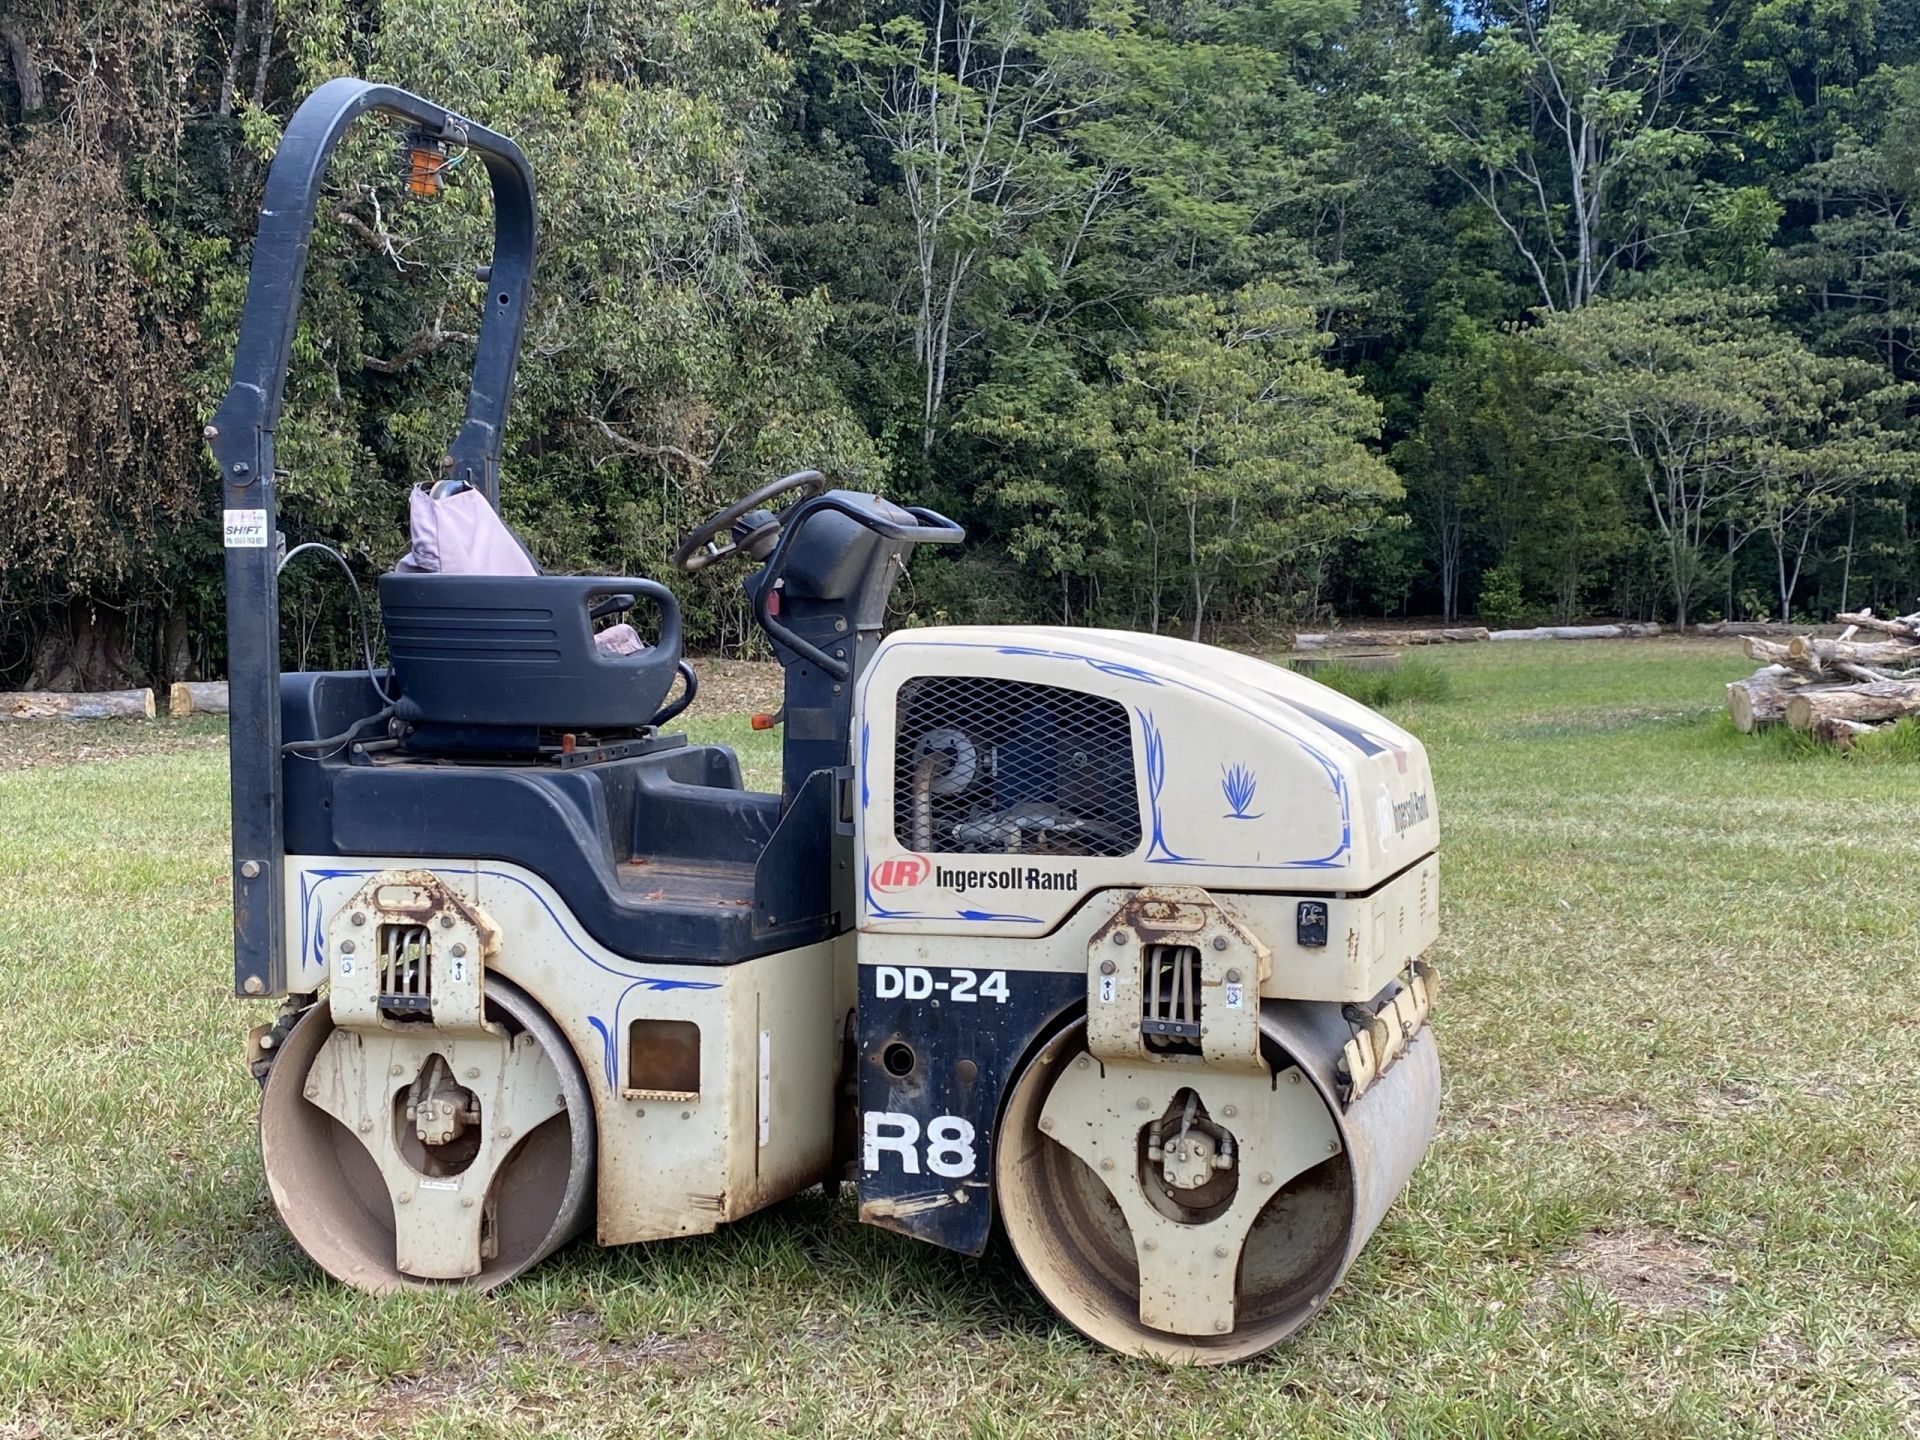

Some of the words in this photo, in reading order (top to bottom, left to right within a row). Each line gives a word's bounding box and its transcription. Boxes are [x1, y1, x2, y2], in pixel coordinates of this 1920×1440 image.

[225, 526, 262, 535] SHIFT
[879, 860, 921, 887] IR
[875, 966, 1010, 1004] DD-24
[863, 1110, 977, 1178] R8
